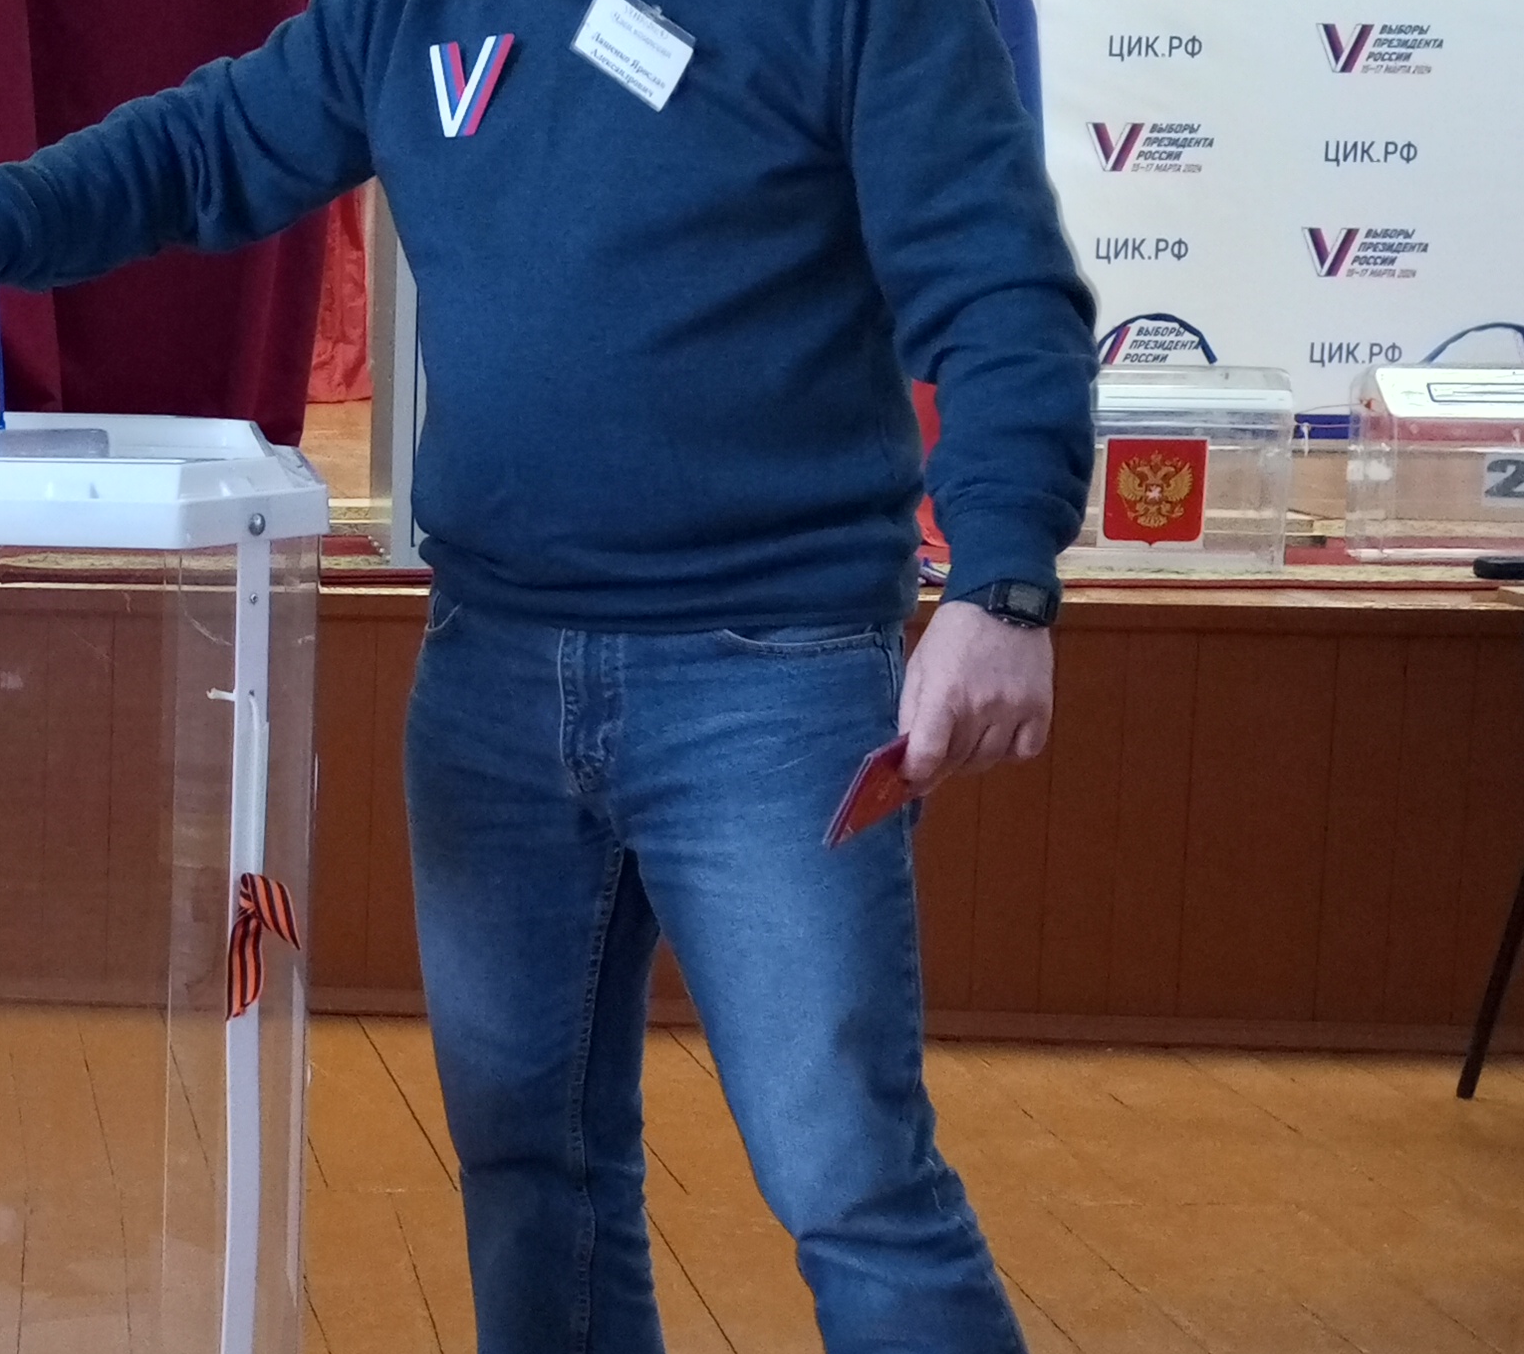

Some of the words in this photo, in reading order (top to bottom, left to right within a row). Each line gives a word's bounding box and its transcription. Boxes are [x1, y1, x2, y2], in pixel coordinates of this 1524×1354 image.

[1379, 24, 1431, 35] ВЫБОРЫ
[1108, 35, 1203, 62] ЦИК.РФ
[1372, 38, 1444, 49] ПРЕЗИДЕНТА
[1365, 51, 1413, 62] РОССИИ
[1149, 123, 1201, 134] ВЫБОРЫ
[1142, 137, 1215, 149] ПРЕЗИДЕНТА
[1136, 150, 1183, 161] РОССИИ
[1323, 140, 1418, 167] ЦИК.РФ
[1364, 228, 1416, 239] ВЫБОРЫ
[1095, 238, 1189, 264] ЦИК.РФ
[1357, 242, 1429, 254] ПРЕЗИДЕНТА
[1351, 255, 1398, 266] РОССИИ
[1136, 326, 1186, 337] ВЫБОРЫ
[1128, 340, 1200, 351] ПРЕЗИДЕНТА
[1122, 353, 1169, 363] РОССИИ
[1309, 342, 1403, 367] ЦИК.РФ
